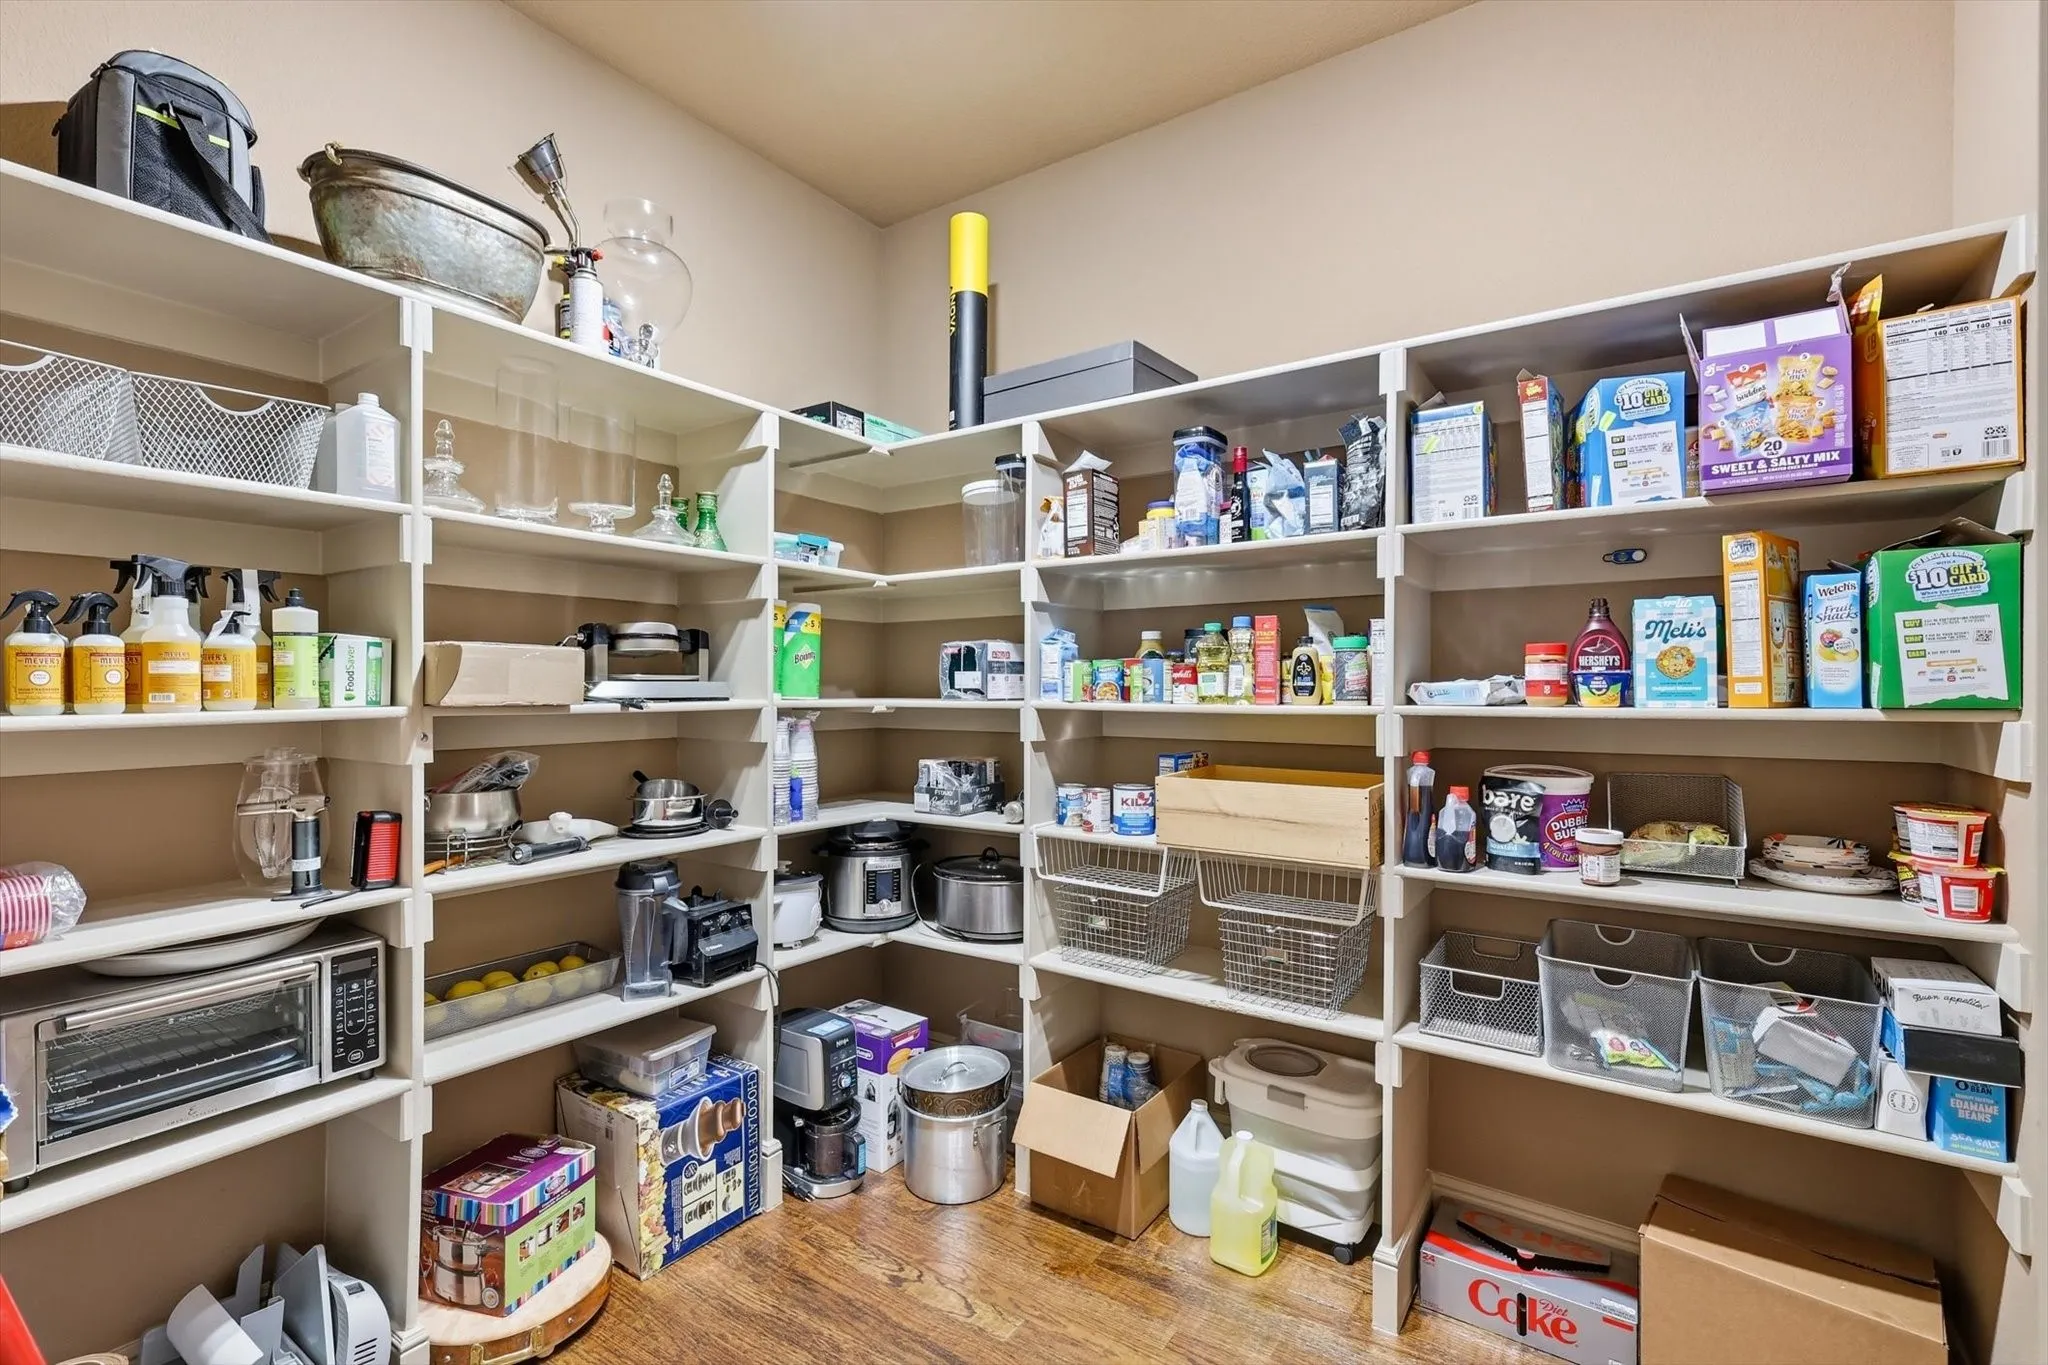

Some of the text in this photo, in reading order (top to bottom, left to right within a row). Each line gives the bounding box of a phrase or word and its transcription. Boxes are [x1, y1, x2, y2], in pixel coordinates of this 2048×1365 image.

[1955, 325, 1970, 333] 140
[1998, 318, 2012, 326] 140
[1934, 329, 1948, 337] 140
[1763, 440, 1783, 452] 20
[1711, 450, 1841, 475] SWEET & SALTY MIX
[1950, 562, 1984, 575] GIFT
[1908, 567, 1949, 591] $10
[1949, 572, 1987, 587] CARD
[1817, 581, 1857, 597] Welch's
[1823, 603, 1854, 615] Fruit
[1815, 610, 1859, 624] Snacks
[1645, 619, 1707, 644] Meli's
[1578, 655, 1621, 666] HERSHEY'S
[344, 645, 356, 692] FoodSaver
[1121, 797, 1150, 807] KILZ
[1482, 783, 1536, 812] bare
[1550, 815, 1588, 831] DUBBLE
[1970, 1085, 1993, 1096] BEAN
[746, 1071, 759, 1146] CHOCOLATE
[1950, 1097, 2000, 1116] EDAMAME
[1957, 1110, 1993, 1124] BEANS
[1950, 1132, 2001, 1149] SEA SALT
[747, 1147, 761, 1212] FOUNTAIN
[1421, 1251, 1436, 1263] 24
[1467, 1278, 1578, 1345] Coke
[1539, 1297, 1569, 1317] Diet
